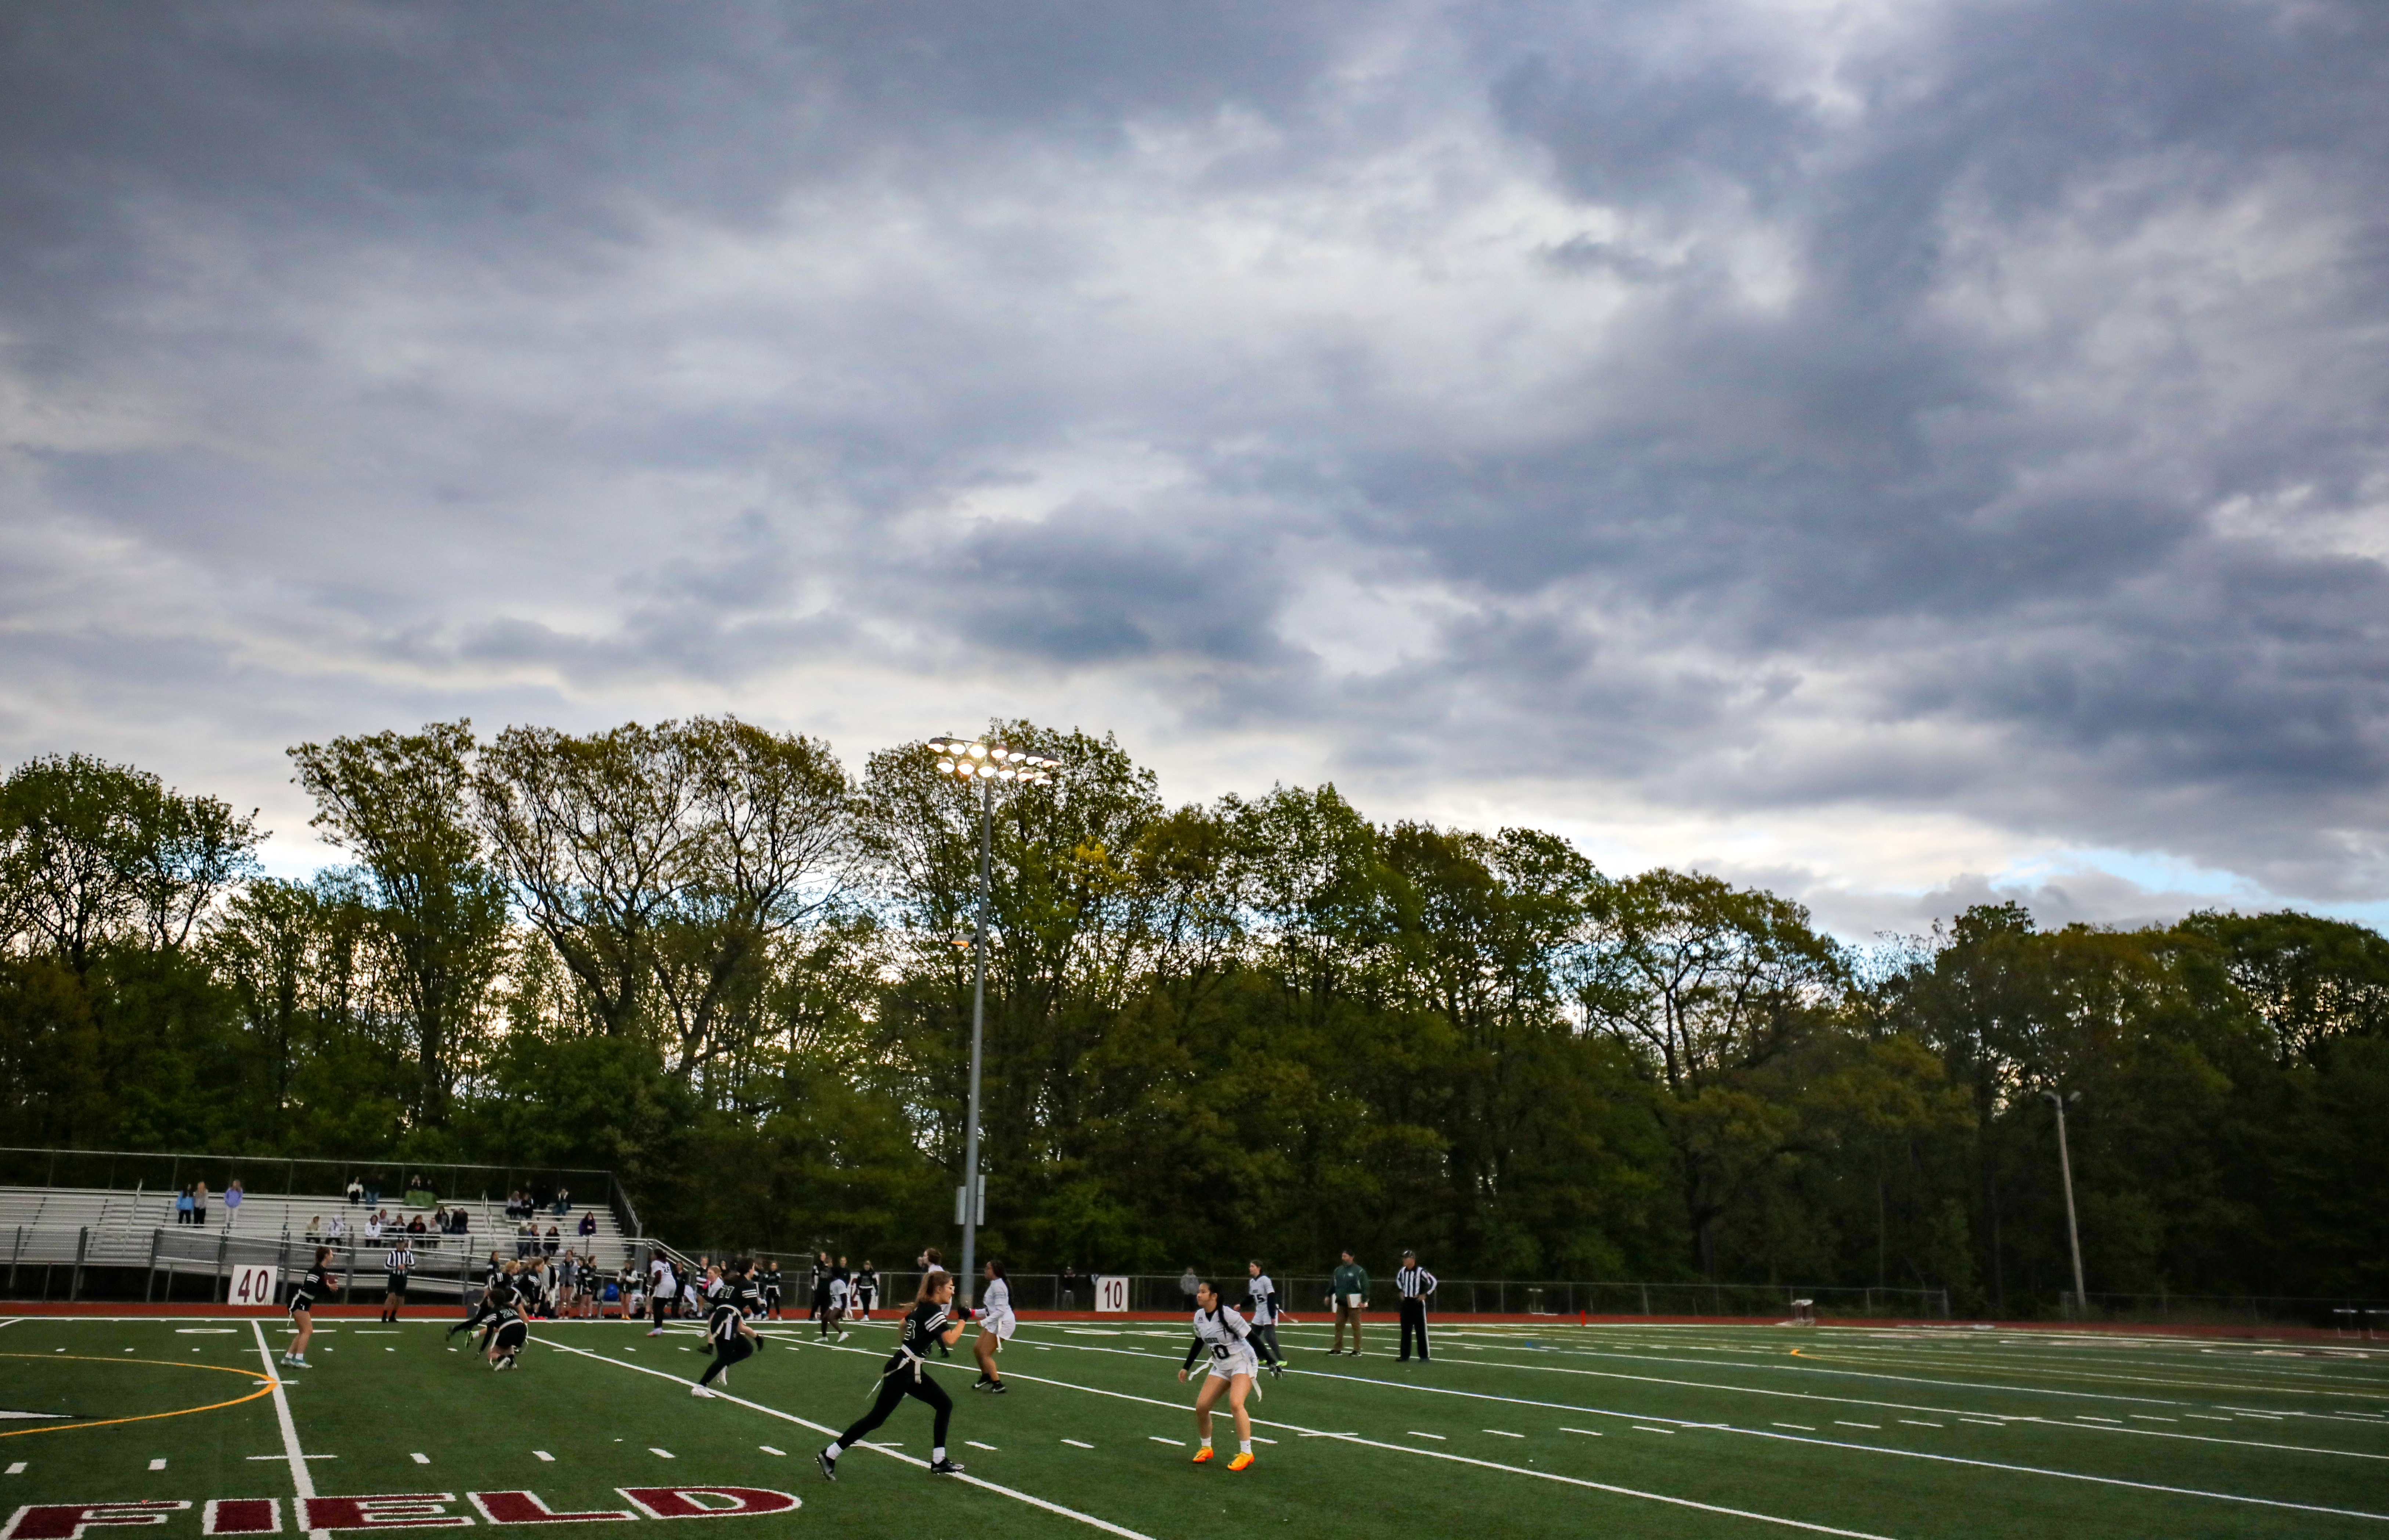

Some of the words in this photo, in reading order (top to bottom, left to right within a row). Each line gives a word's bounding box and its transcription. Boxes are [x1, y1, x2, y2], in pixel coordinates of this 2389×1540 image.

[238, 1269, 268, 1303] 40
[1104, 1280, 1122, 1309] 10
[1254, 1294, 1265, 1303] 5
[1212, 1344, 1230, 1360] 0
[0, 1486, 802, 1540] FIELD
